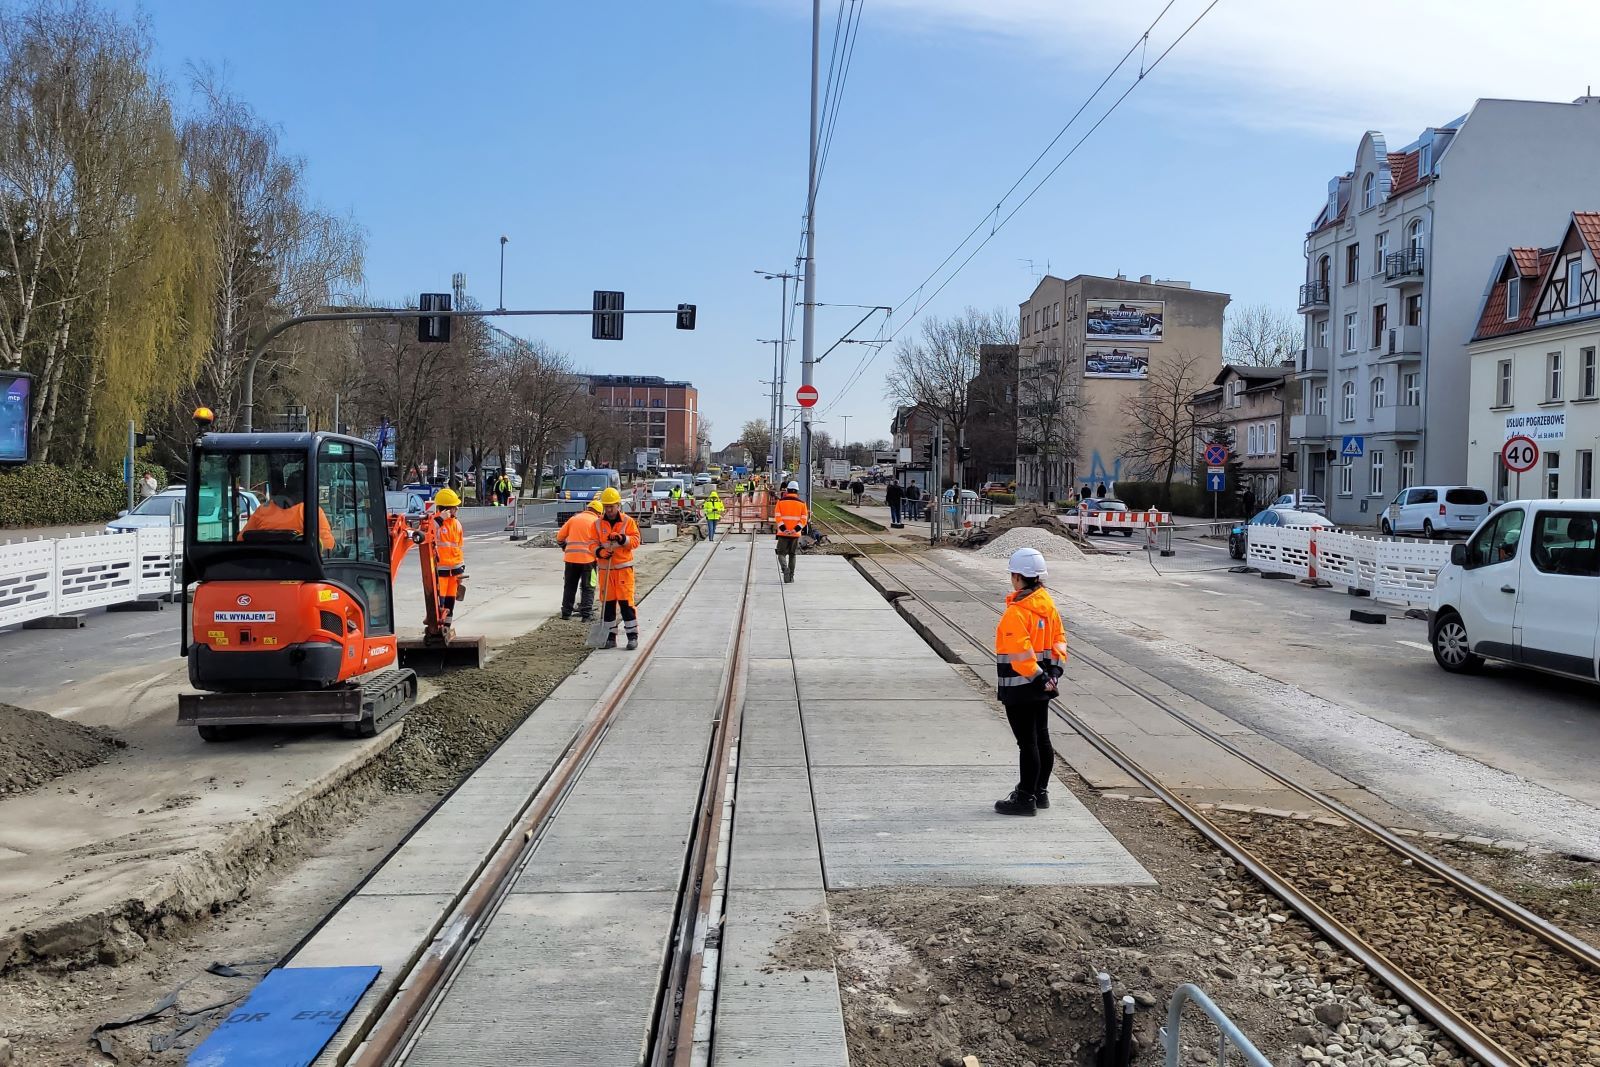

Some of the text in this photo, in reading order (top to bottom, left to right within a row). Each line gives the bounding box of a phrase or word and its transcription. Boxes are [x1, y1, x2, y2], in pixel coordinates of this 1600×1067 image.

[1506, 414, 1565, 428] USŁUGI POGRZEBOWE
[1507, 446, 1534, 464] 40
[215, 613, 266, 621] HKL WYNAJEM
